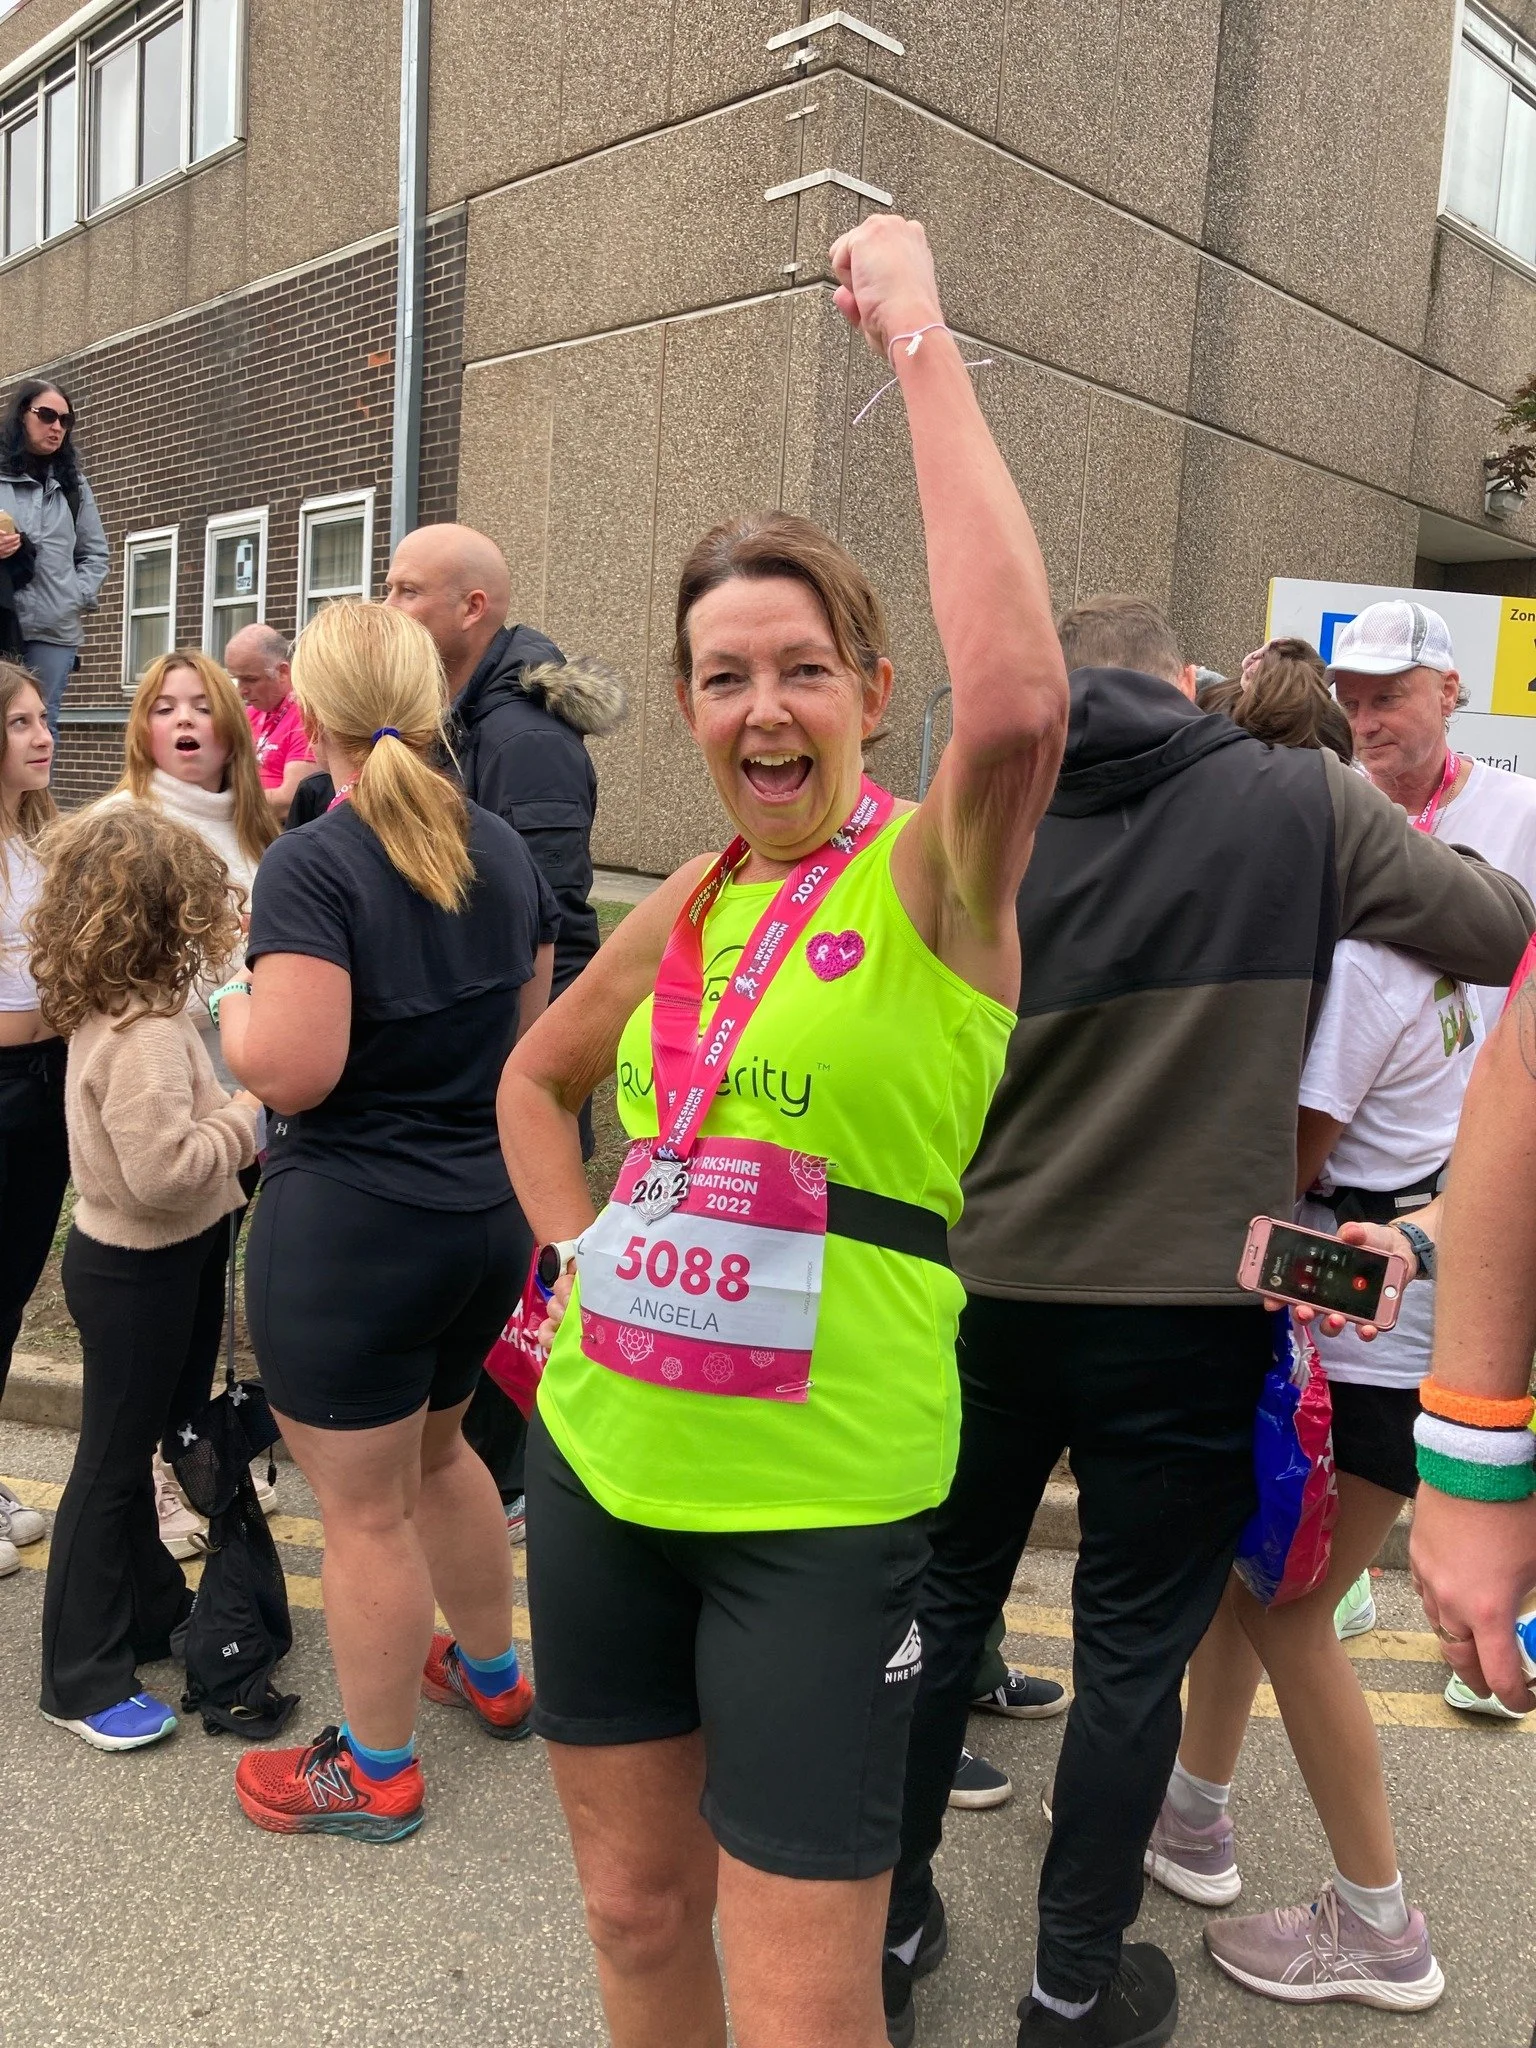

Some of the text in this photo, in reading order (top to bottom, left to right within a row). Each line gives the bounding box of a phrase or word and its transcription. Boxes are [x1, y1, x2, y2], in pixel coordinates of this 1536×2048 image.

[1456, 751, 1518, 773] tral
[845, 794, 872, 831] YRKSHIRE
[791, 865, 829, 904] 2022
[747, 920, 781, 973] YRKSHIRE
[756, 923, 789, 976] MARATHON
[815, 944, 857, 962] R L
[704, 1018, 736, 1067] 2022
[667, 1086, 698, 1144] YRKSHIRE
[674, 1088, 705, 1145] MARATHON
[690, 1156, 762, 1177] YRKSHIRE
[690, 1173, 759, 1196] ARATHON
[705, 1193, 752, 1215] 2022
[615, 1236, 750, 1302] 5088
[629, 1296, 720, 1333] ANGELA
[803, 1292, 811, 1315] ANGELA
[885, 1669, 909, 1684] NIKE
